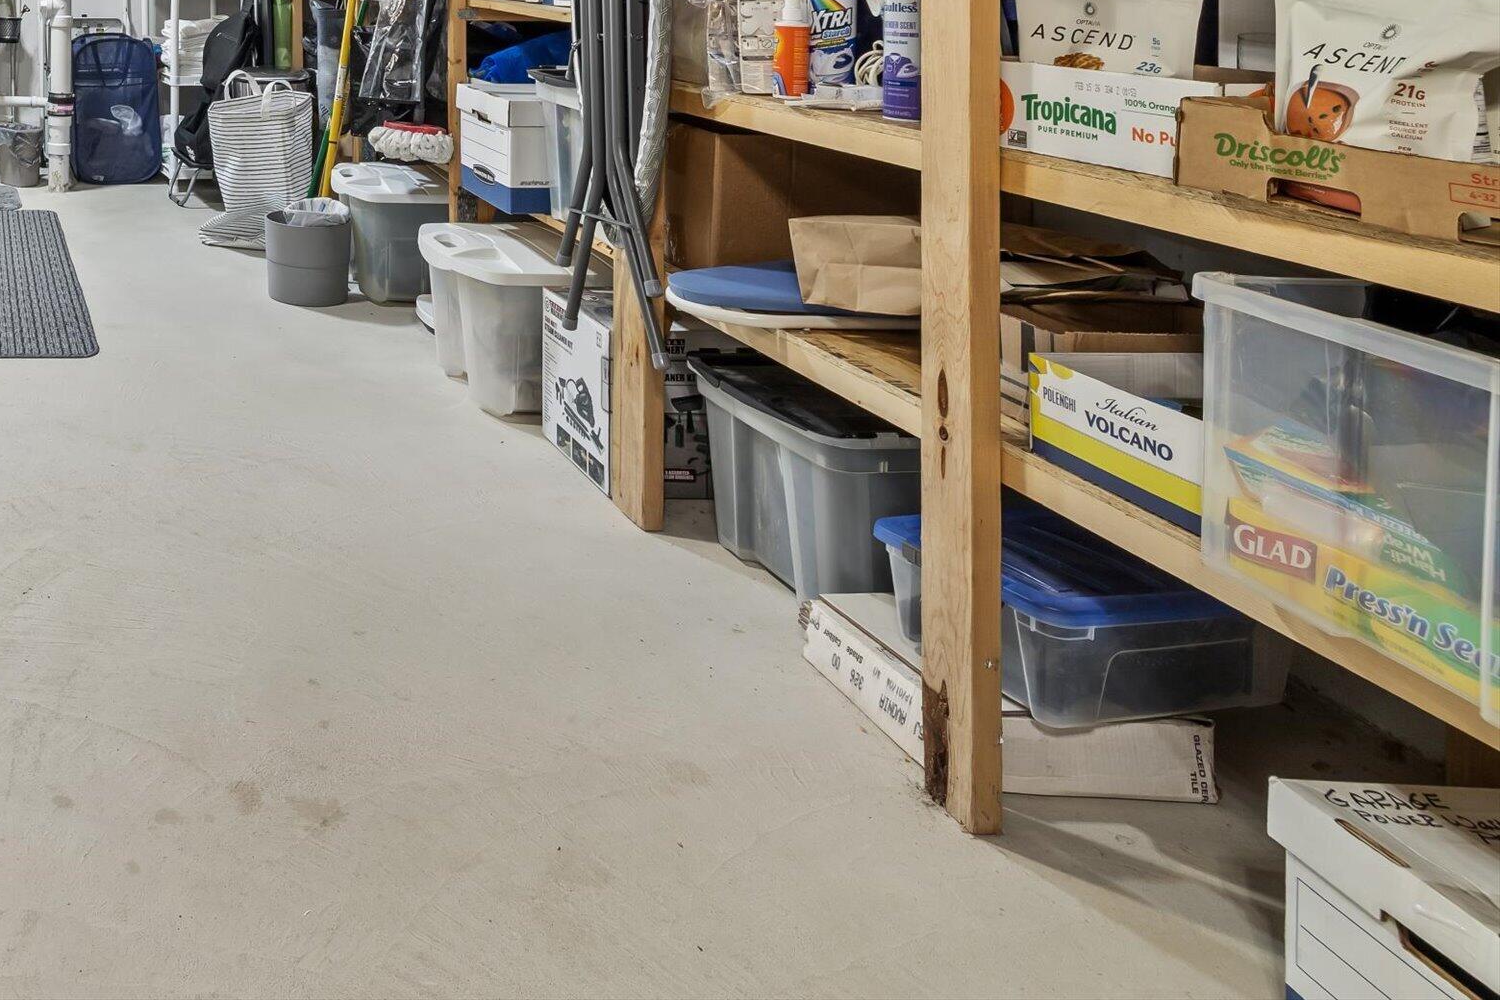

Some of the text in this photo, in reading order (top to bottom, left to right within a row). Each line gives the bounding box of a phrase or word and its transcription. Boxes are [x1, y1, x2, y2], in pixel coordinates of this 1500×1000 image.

[1030, 23, 1135, 51] ASCEND
[1136, 61, 1162, 74] 23G
[1394, 82, 1426, 100] 21G
[1021, 94, 1117, 135] Tropicana
[1124, 98, 1176, 114] 100% Orang
[1390, 98, 1426, 108] PROTEIN
[1037, 125, 1099, 141] PURE PREMIUM
[1389, 119, 1428, 128] EXCELLENT
[1389, 126, 1416, 135] SOURCE
[1132, 126, 1177, 147] No Pu
[1391, 132, 1423, 141] CALCIUM
[1213, 132, 1343, 174] Driscoll's
[1229, 158, 1328, 181] Only the Finest Berries
[1042, 386, 1077, 413] POLENGHI
[1095, 398, 1159, 432] Italian
[1084, 409, 1173, 462] VOLCANO
[1233, 524, 1312, 570] GLAD
[1324, 564, 1429, 641] Press'n
[1192, 734, 1207, 779] GLAZED
[1190, 771, 1200, 795] TILE
[1324, 788, 1451, 811] GARAGE
[1352, 808, 1444, 828] POWER
